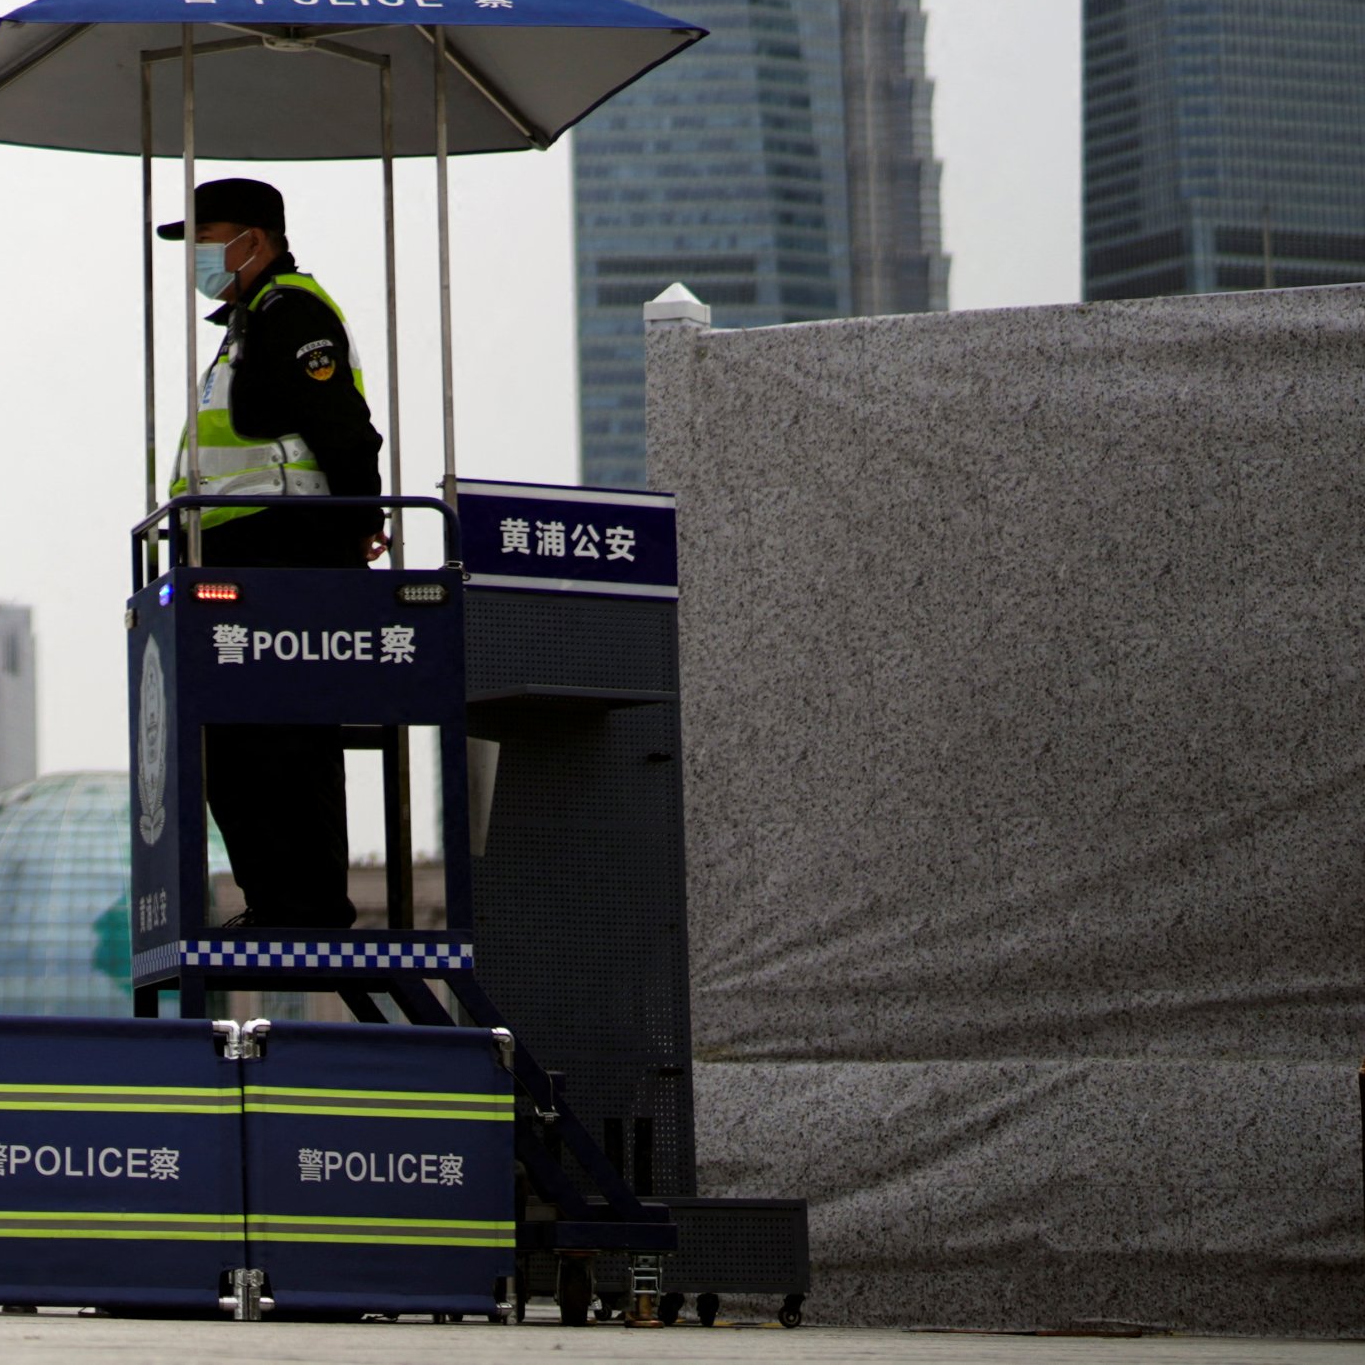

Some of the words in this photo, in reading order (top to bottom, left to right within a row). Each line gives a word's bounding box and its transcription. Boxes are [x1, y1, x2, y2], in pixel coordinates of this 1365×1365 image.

[499, 517, 636, 563] 黄浦公安
[212, 624, 249, 665] 警
[252, 630, 374, 662] POLICE
[379, 624, 417, 665] 察
